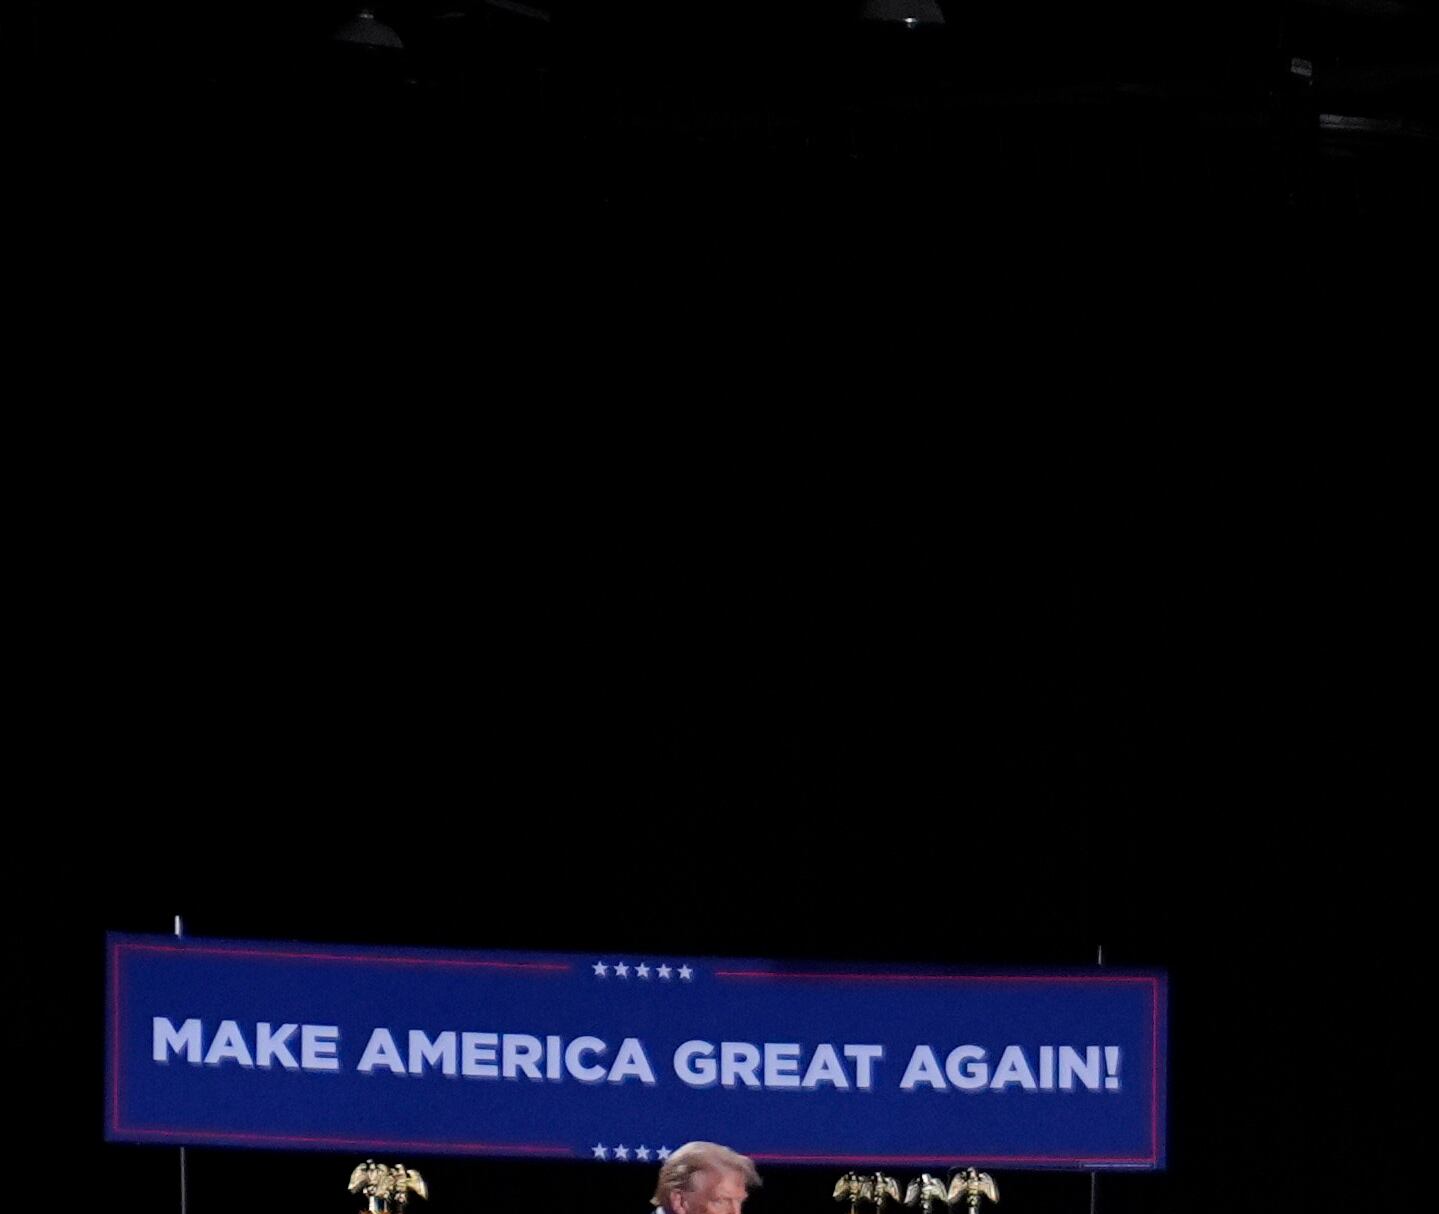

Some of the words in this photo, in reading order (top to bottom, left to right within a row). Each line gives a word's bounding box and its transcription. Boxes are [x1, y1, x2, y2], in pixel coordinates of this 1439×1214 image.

[152, 1017, 340, 1070] MAKE
[357, 1028, 655, 1083] AMERICA
[673, 1040, 882, 1088] GREAT
[899, 1044, 1119, 1090] AGAIN!
